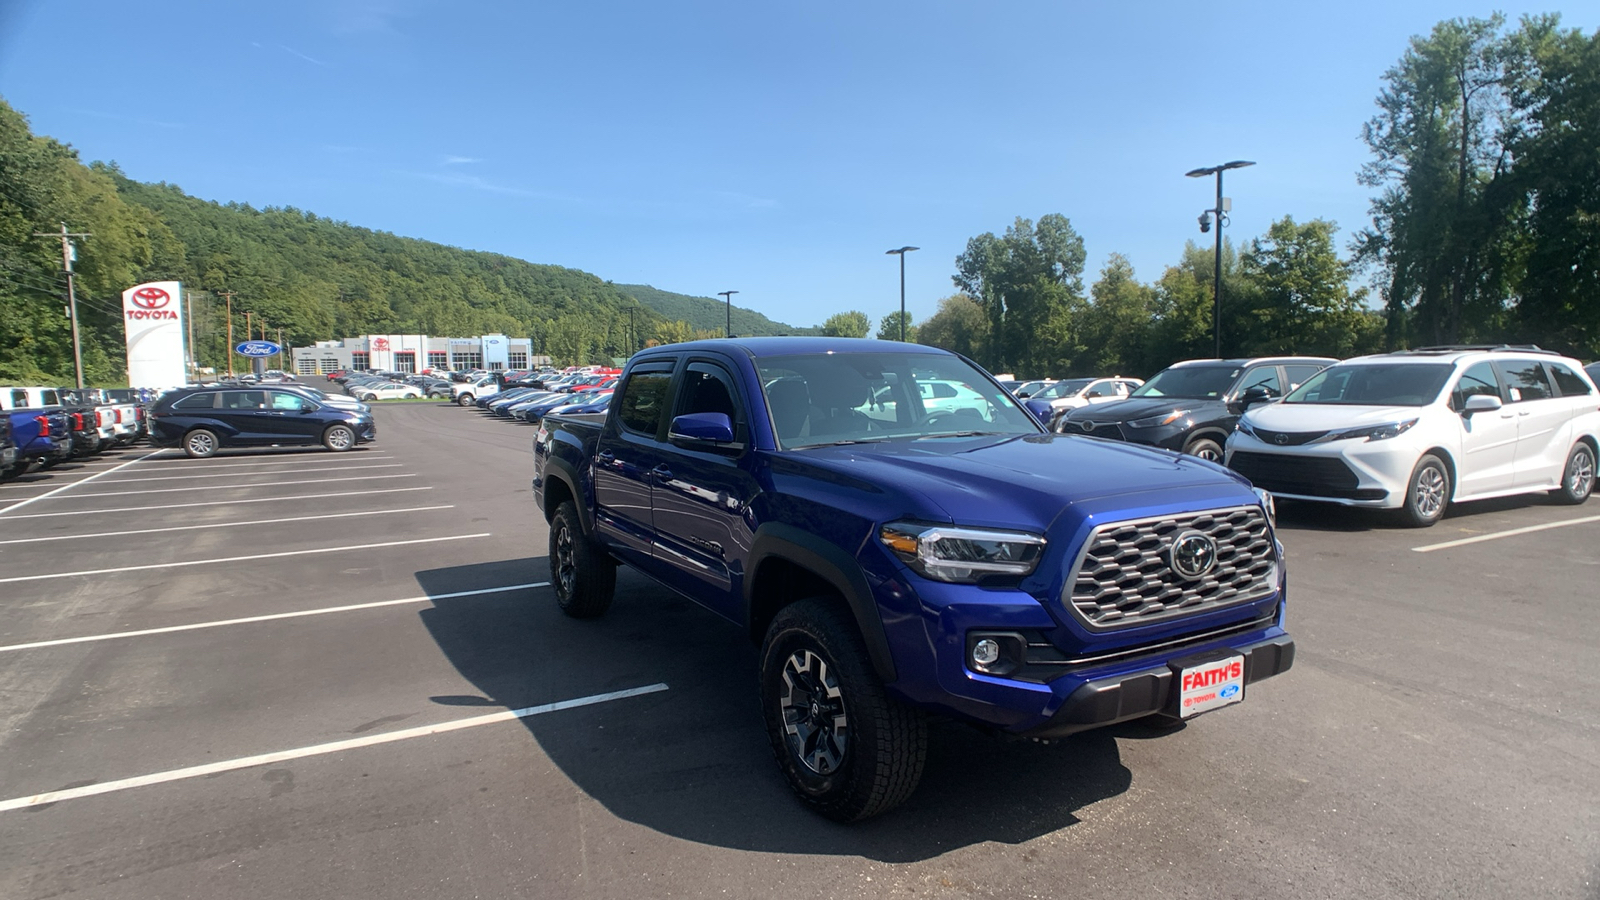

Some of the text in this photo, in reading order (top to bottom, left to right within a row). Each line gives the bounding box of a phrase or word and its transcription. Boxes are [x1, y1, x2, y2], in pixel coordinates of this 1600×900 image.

[127, 310, 178, 320] TOYOTA
[244, 343, 272, 354] Ford
[1183, 662, 1241, 691] FAITH'S
[1193, 692, 1216, 703] TOYOTA
